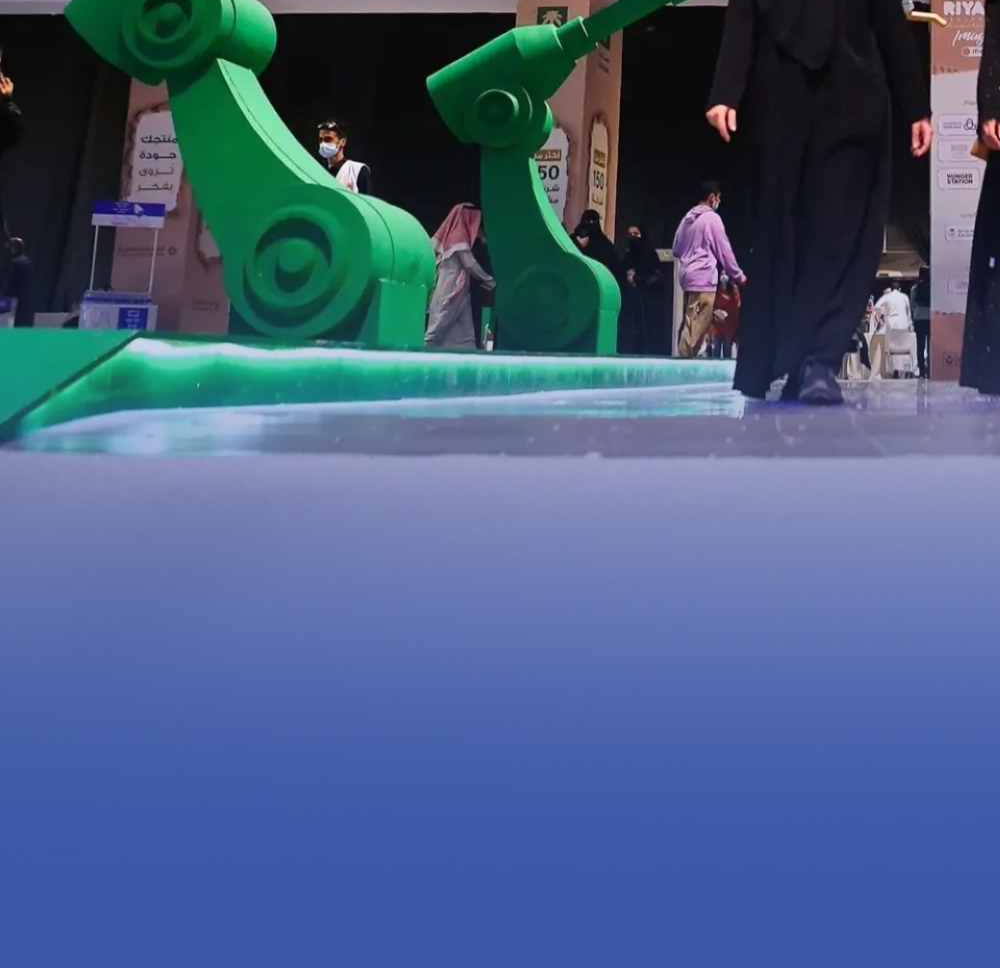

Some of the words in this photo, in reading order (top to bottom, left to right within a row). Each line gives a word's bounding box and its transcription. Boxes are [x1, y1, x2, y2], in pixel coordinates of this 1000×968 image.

[943, 0, 985, 16] RIYA
[952, 30, 984, 47] Imag
[537, 164, 560, 180] 50
